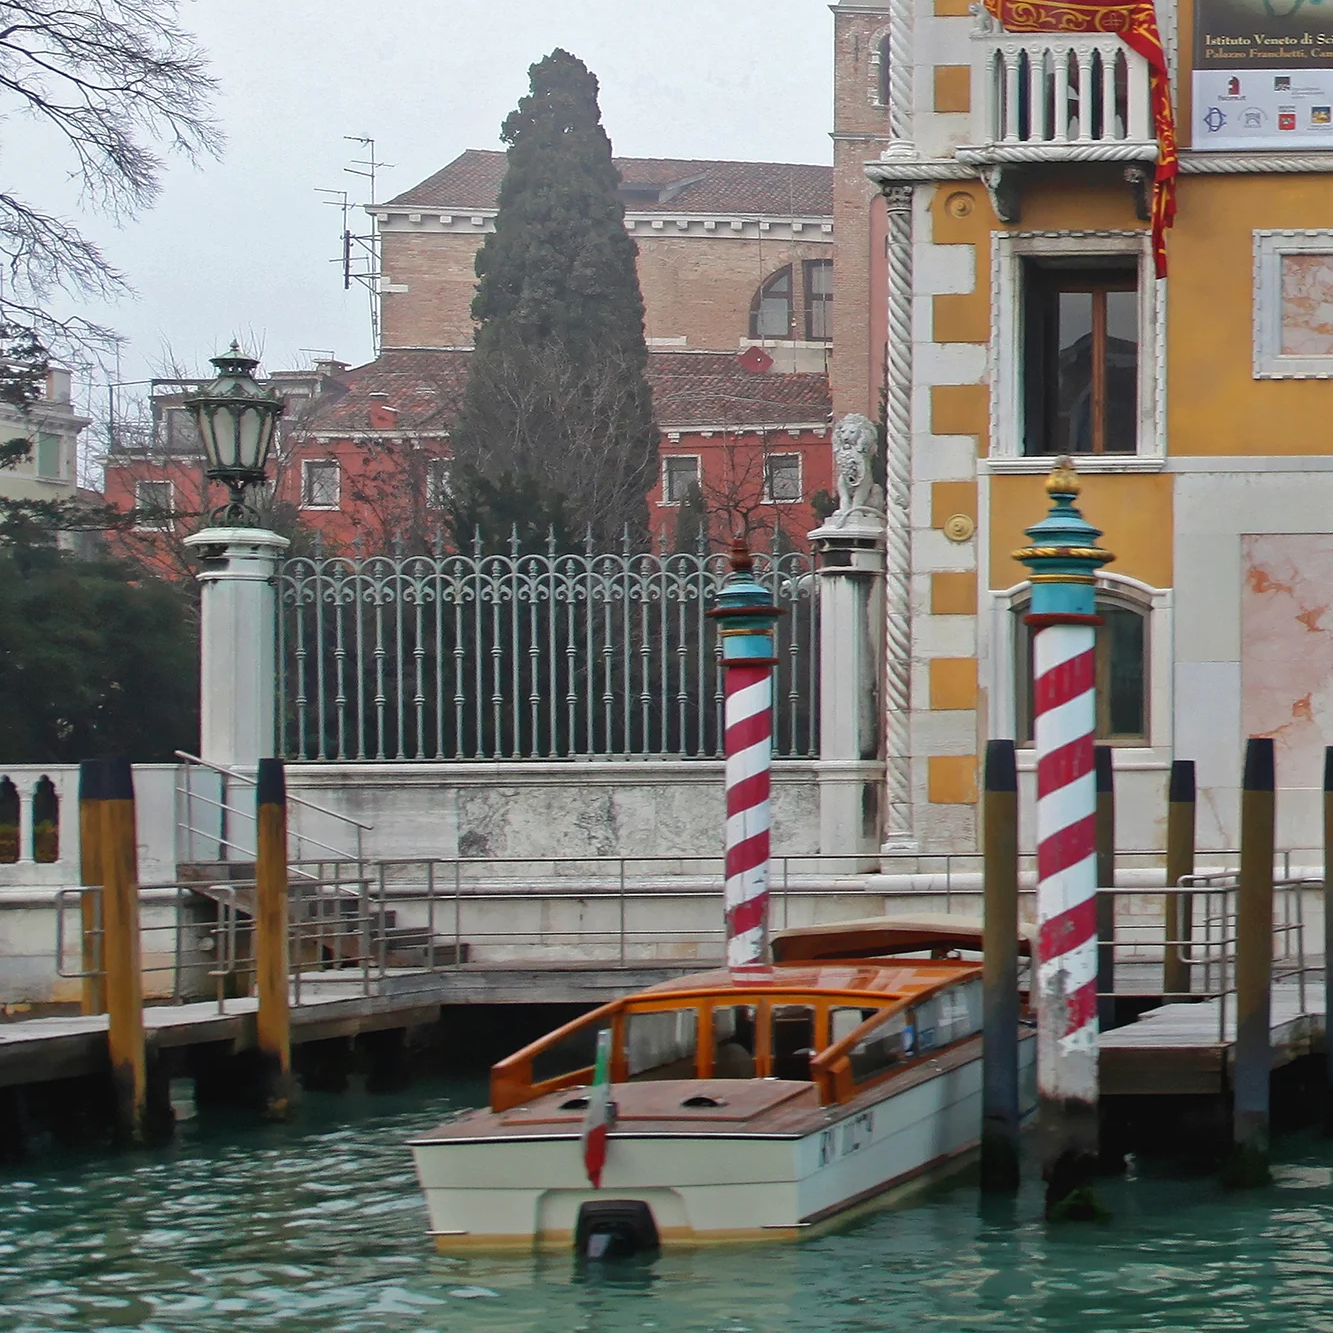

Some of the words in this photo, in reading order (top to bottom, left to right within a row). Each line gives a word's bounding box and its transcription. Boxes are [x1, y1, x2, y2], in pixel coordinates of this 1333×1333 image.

[1205, 33, 1251, 45] Istituto
[1253, 33, 1298, 45] Veneto
[1300, 32, 1313, 45] di
[1205, 47, 1247, 59] Palazzo
